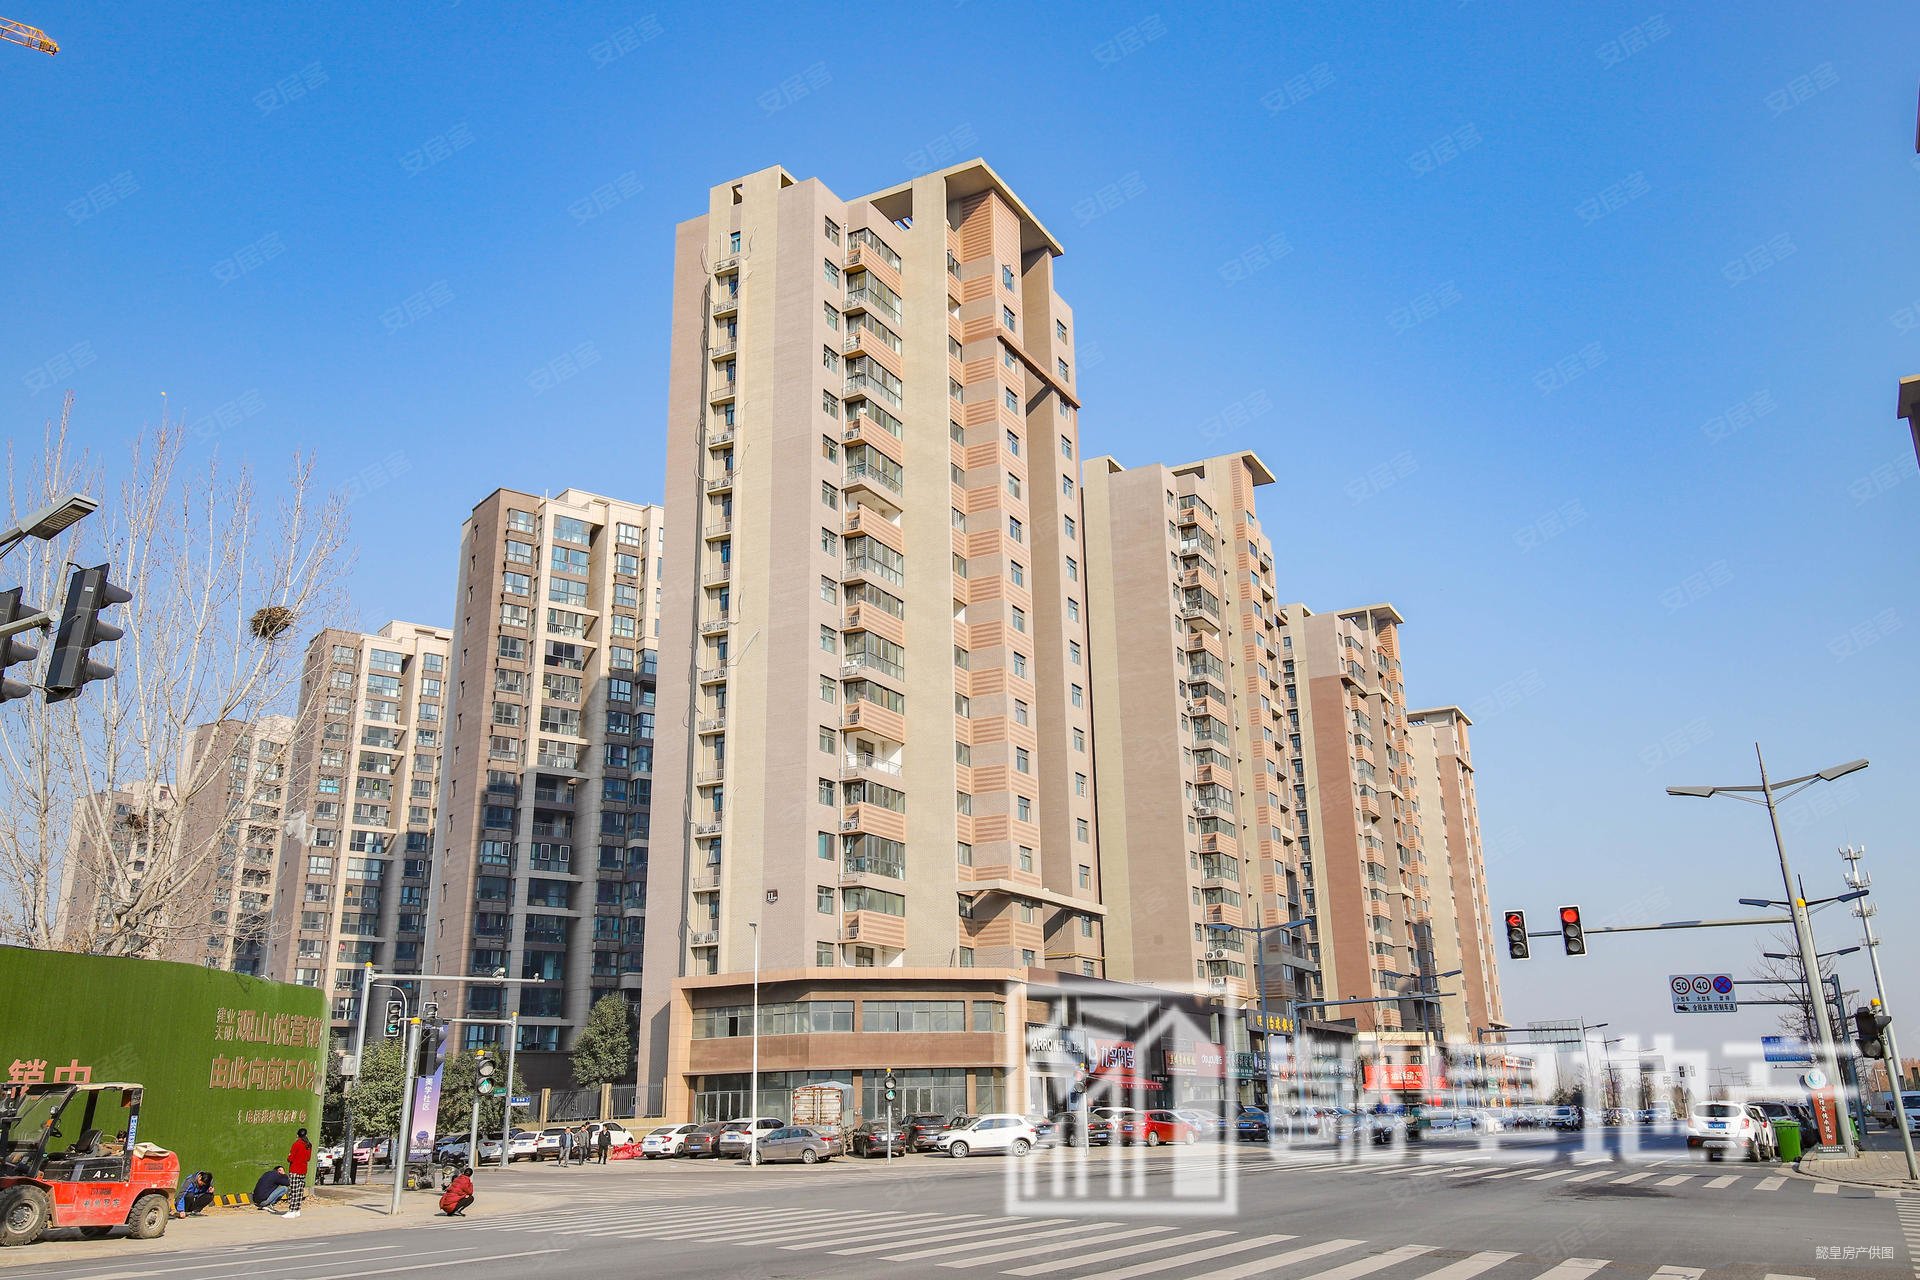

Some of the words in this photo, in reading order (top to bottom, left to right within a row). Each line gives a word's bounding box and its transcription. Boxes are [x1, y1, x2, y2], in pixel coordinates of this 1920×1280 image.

[1675, 982, 1687, 991] 50
[1696, 981, 1708, 990] 40
[216, 1006, 236, 1024] 建业
